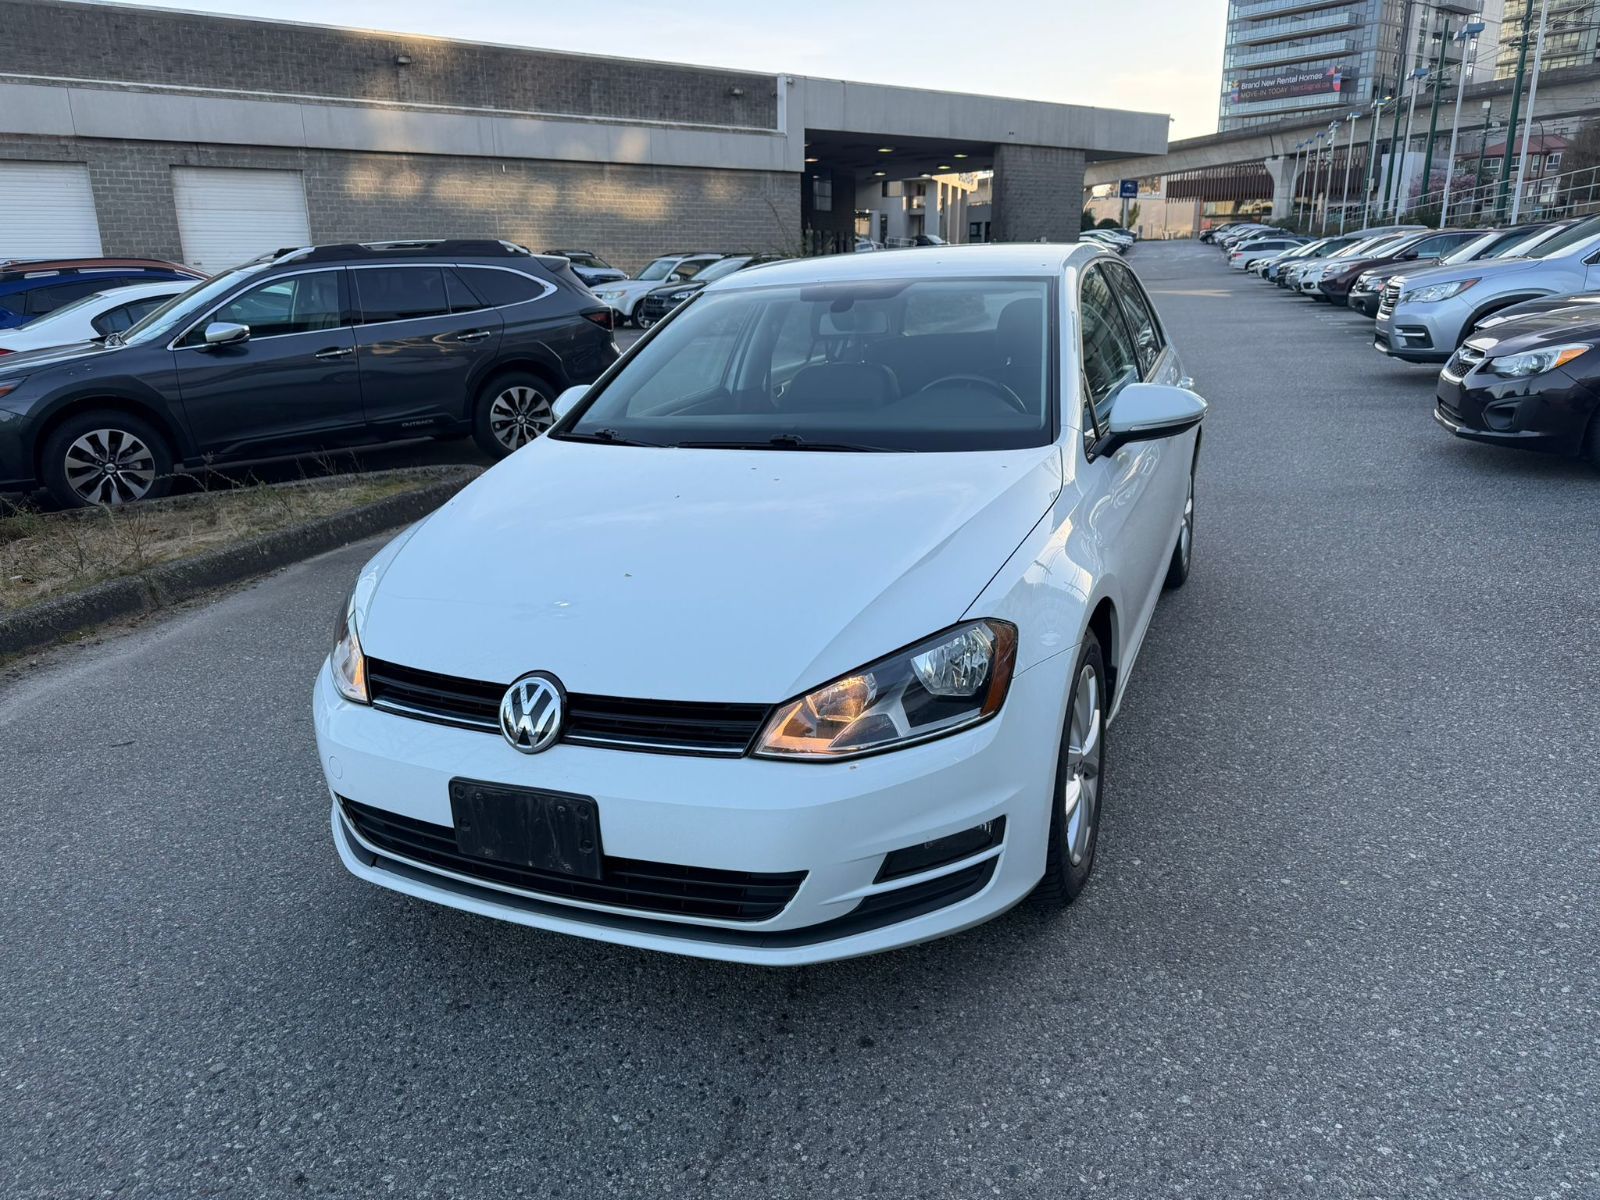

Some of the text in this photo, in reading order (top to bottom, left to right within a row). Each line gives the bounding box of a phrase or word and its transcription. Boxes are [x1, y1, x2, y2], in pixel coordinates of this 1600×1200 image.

[1241, 73, 1323, 90] Brand New Rental Homes
[1268, 87, 1288, 95] TODAY
